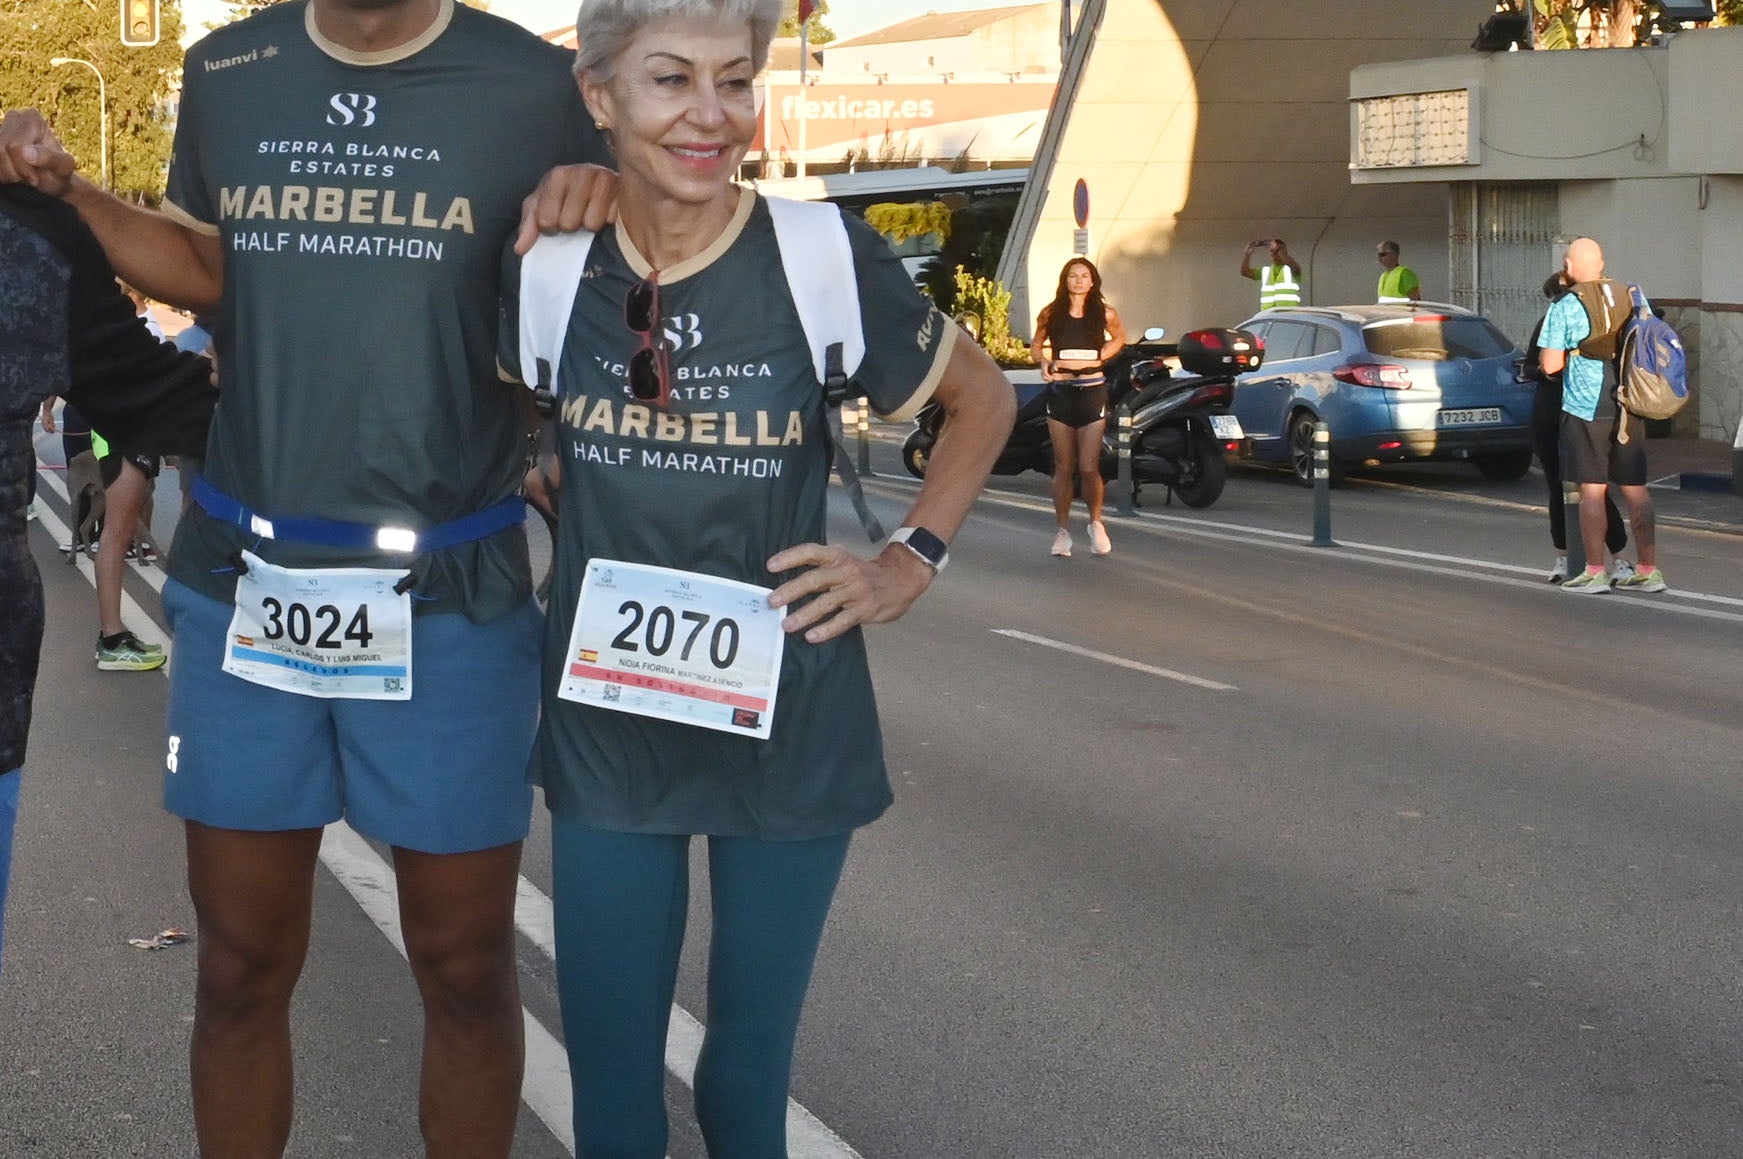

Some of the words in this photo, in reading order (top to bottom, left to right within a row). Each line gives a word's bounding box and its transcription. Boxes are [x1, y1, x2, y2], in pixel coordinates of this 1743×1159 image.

[205, 49, 258, 72] luanvi
[326, 92, 377, 127] SB
[781, 94, 935, 121] flexicar.es
[257, 140, 335, 154] SIERRA
[345, 142, 441, 162] BLANCA
[289, 160, 395, 177] ESTATES
[219, 184, 475, 234] MARBELLA
[233, 232, 290, 252] HALF
[299, 233, 444, 261] MARATHON
[659, 313, 703, 352] SB
[677, 363, 772, 381] BLANCA
[560, 391, 803, 447] MARBELLA
[1444, 411, 1475, 423] 7232
[1479, 410, 1499, 421] JCB
[573, 440, 632, 466] HALF
[642, 449, 783, 479] MARATHON
[262, 596, 373, 649] 3024
[610, 600, 740, 670] 2070
[295, 648, 324, 663] CARLOS
[333, 655, 351, 663] LUIS
[352, 654, 382, 662] MIGUEL
[618, 658, 641, 670] NIDIA
[642, 662, 675, 676] FIORINA
